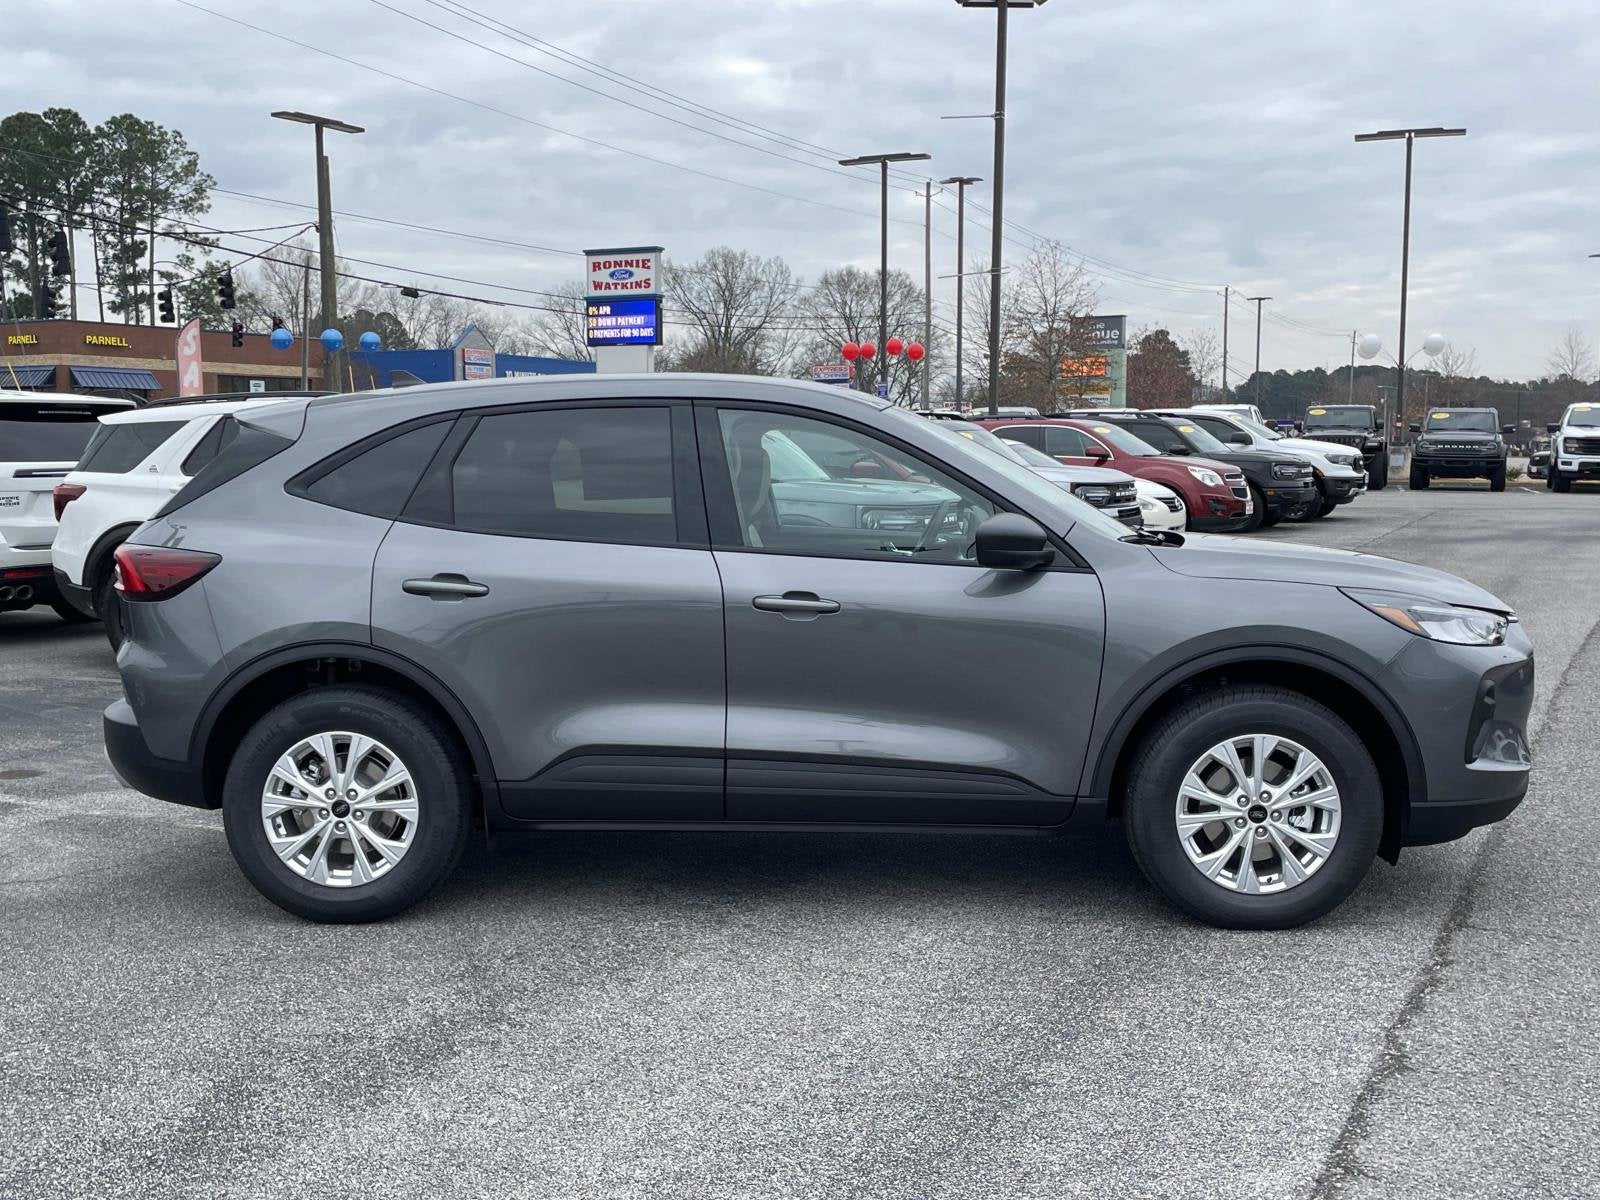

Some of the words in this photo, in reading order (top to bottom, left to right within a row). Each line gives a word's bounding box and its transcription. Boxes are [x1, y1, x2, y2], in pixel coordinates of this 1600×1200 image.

[592, 258, 651, 272] RONNIE
[592, 278, 651, 291] WATKINS
[599, 305, 611, 315] APR
[598, 317, 616, 326] DOWN
[617, 316, 645, 325] PAYMENT
[594, 328, 620, 338] PAYMENTS
[621, 328, 632, 337] FOR
[632, 328, 640, 337] 90
[640, 327, 654, 336] DAYS
[8, 335, 37, 345] PARNELL
[86, 335, 129, 347] PARNELL
